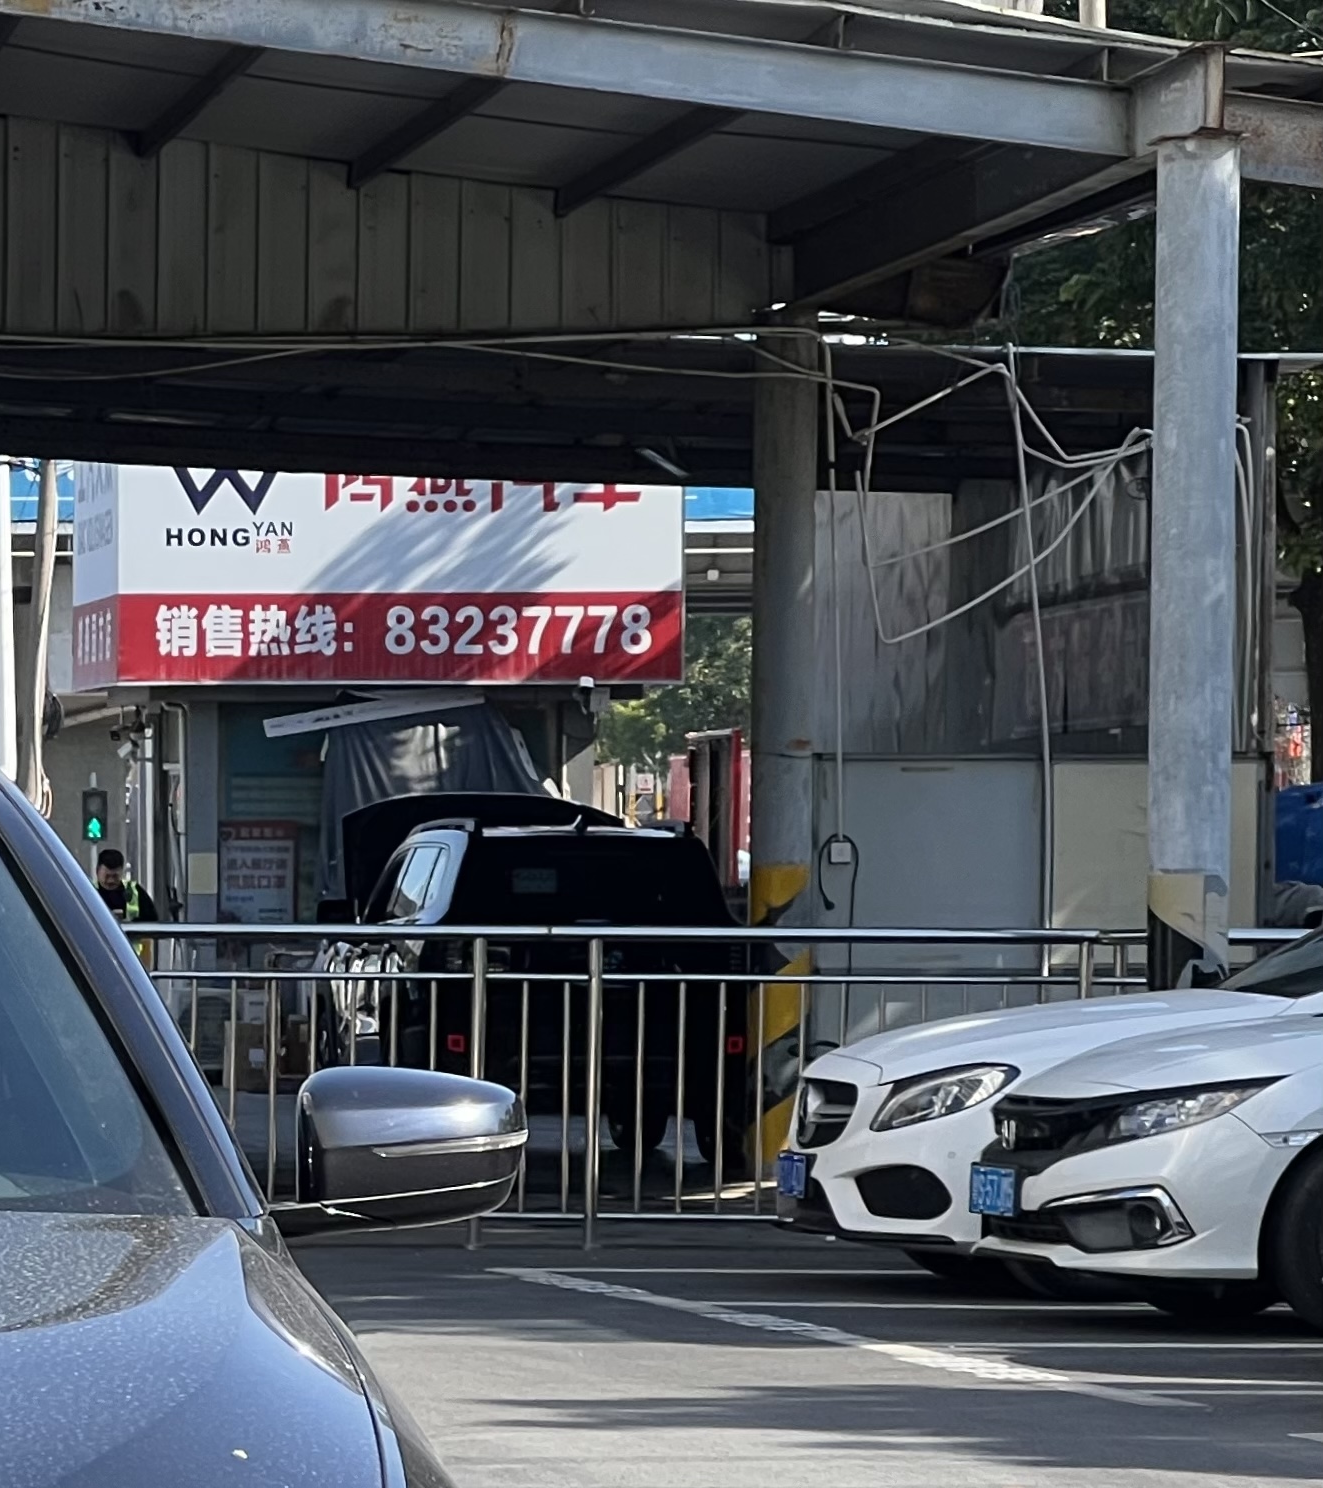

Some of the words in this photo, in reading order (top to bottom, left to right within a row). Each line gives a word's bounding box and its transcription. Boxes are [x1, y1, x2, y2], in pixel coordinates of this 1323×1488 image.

[165, 527, 251, 547] HONG
[252, 521, 293, 537] YAN
[385, 605, 652, 656] 83237778
